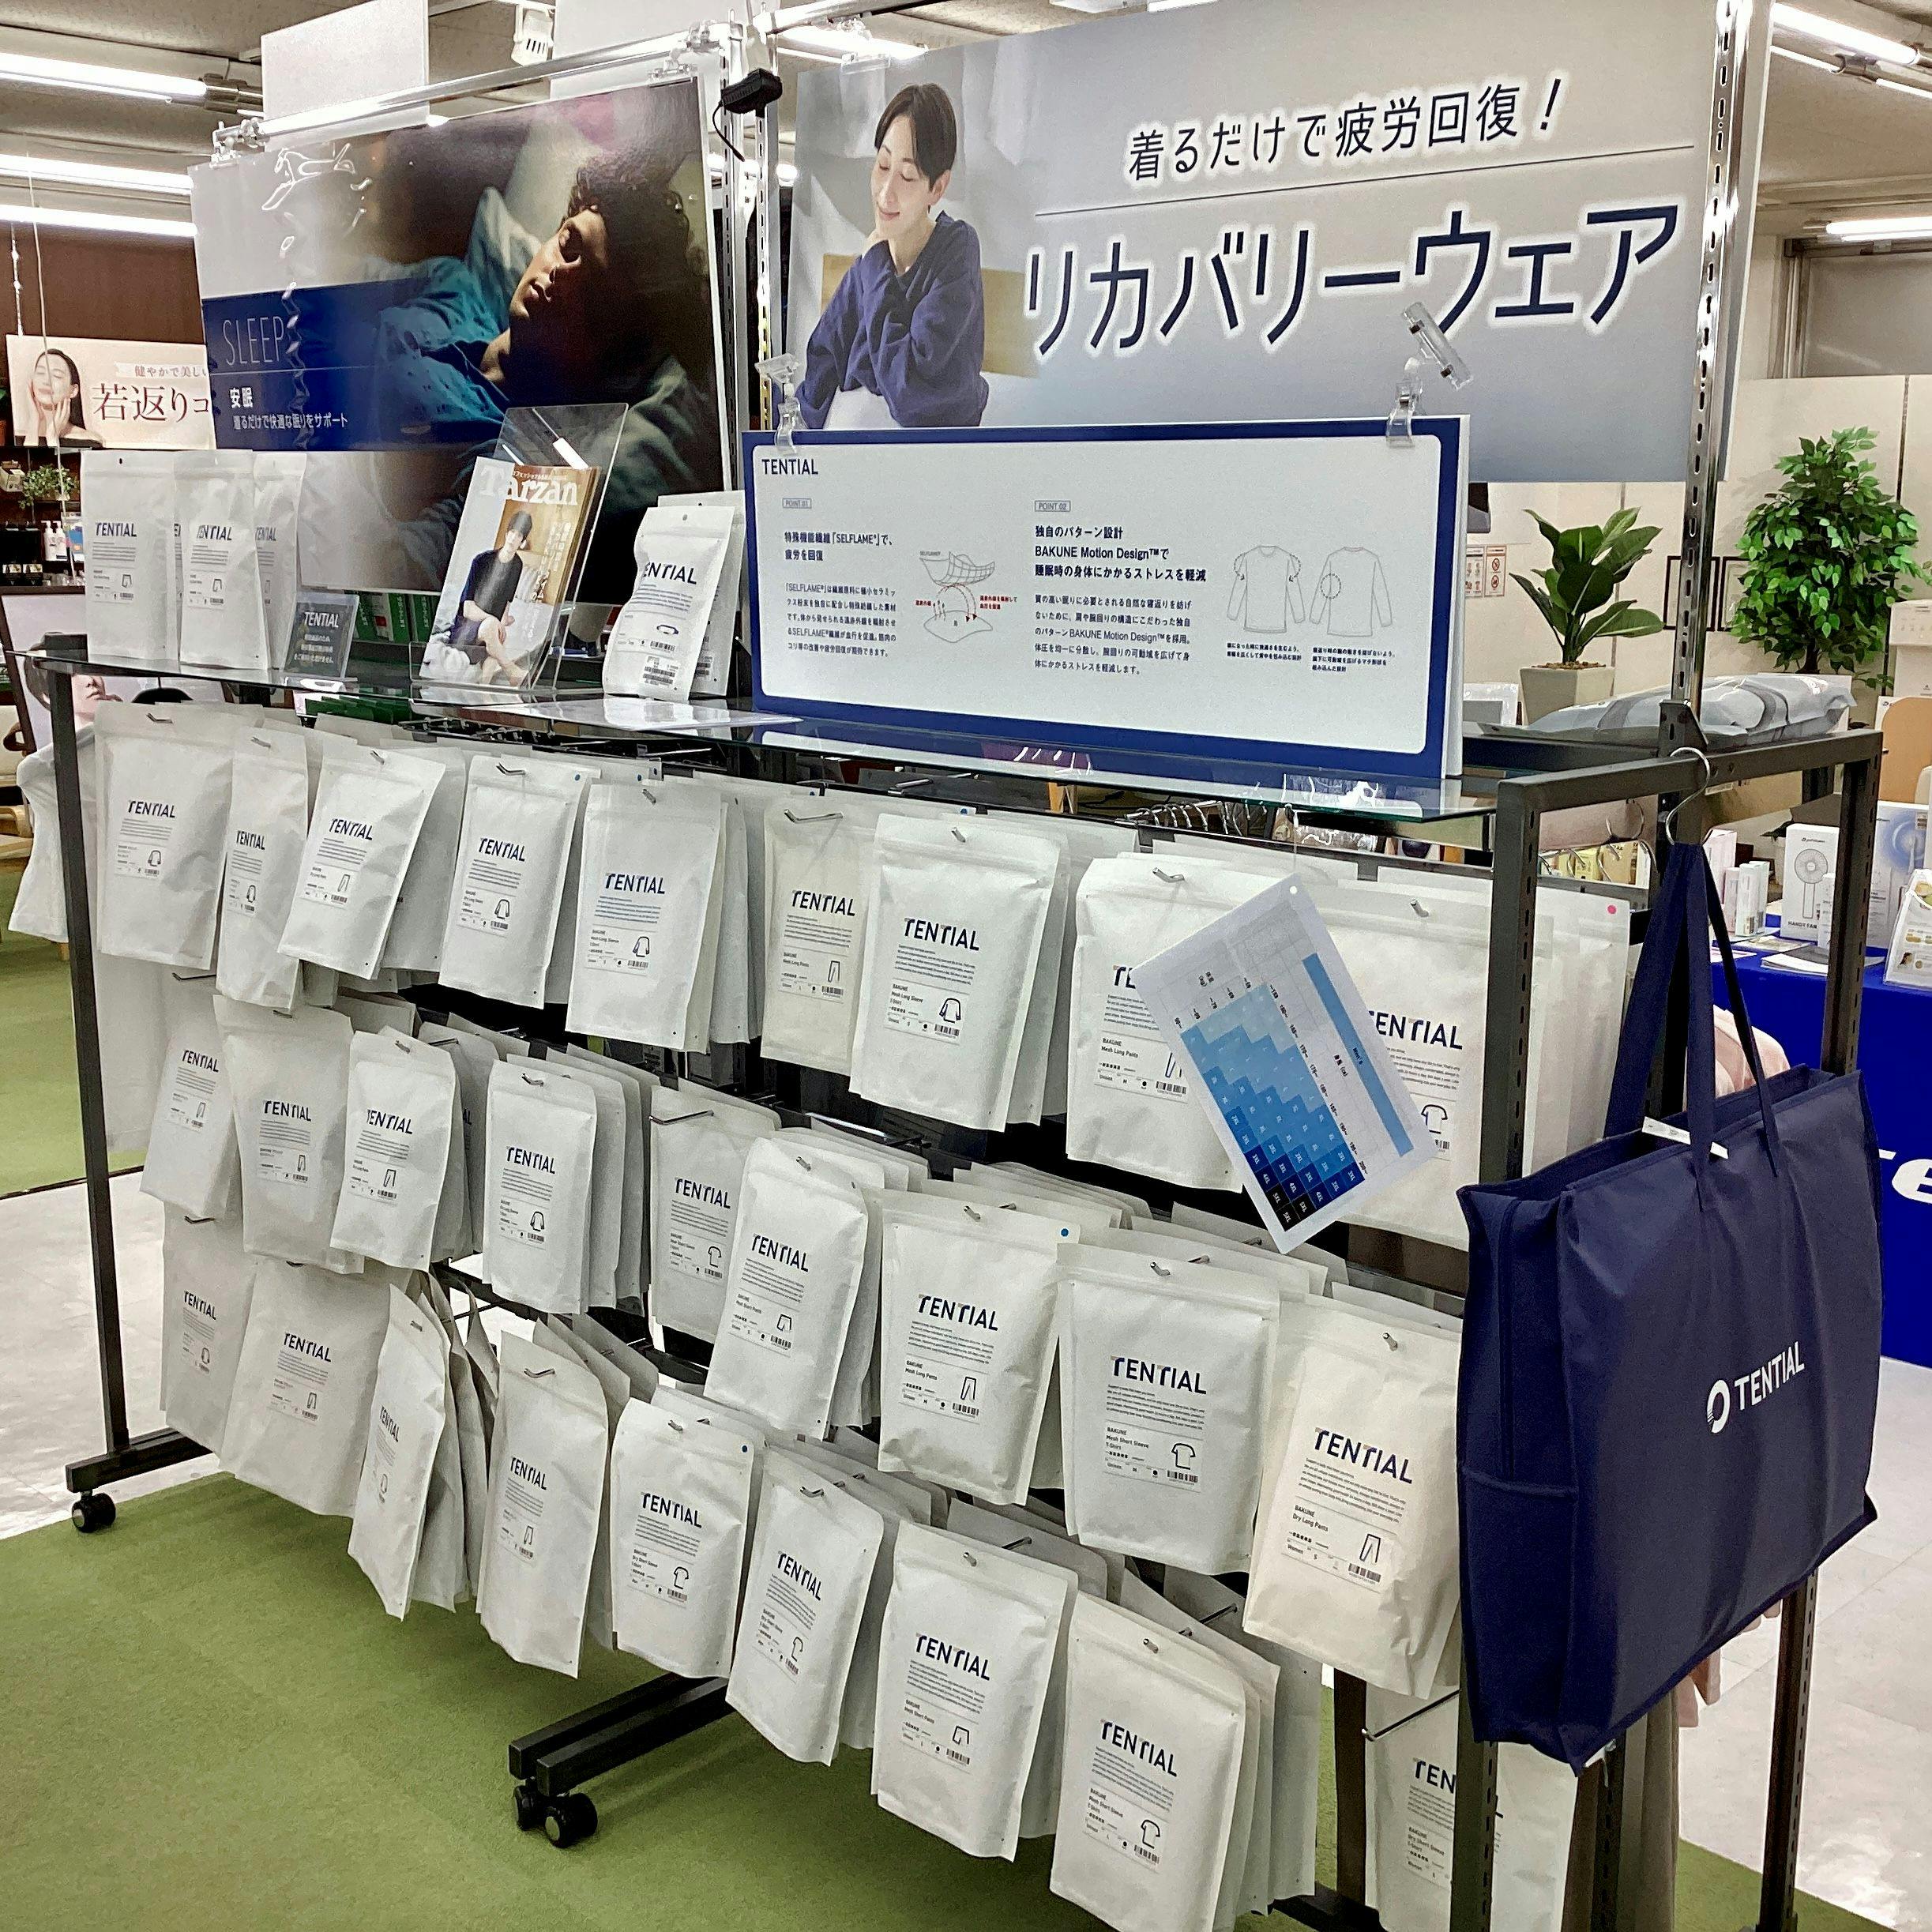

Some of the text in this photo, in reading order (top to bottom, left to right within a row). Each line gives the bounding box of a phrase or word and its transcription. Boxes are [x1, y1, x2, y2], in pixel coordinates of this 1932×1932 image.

[1128, 78, 1562, 182] 着るだけで疲労回復！
[1028, 203, 1677, 355] リカバリーウェア
[222, 317, 284, 366] SLEEP
[229, 386, 254, 408] 安眠
[761, 457, 818, 476] TENTIAL
[1038, 502, 1067, 511] POINT 02
[94, 522, 137, 538] TENTIAL
[1036, 524, 1123, 540] 独自のパターン設計
[785, 549, 824, 562] 疲労を回復
[1035, 545, 1077, 558] BAKUNE
[1081, 547, 1113, 559] Motion
[1035, 564, 1207, 582] 睡眠時の身体にかかるストレスを軽減
[304, 611, 339, 628] TENTIAL
[1035, 659, 1141, 675] 体にかかるストレスを軽減します。
[128, 799, 176, 818] TENTIAL
[235, 829, 265, 851] TENTIAL
[329, 817, 374, 841] TENTIAL
[477, 836, 526, 863] TENTIAL
[604, 872, 666, 895] TENTIAL
[791, 889, 856, 917] TENTIAL
[904, 916, 980, 952] TENTIAL
[182, 1049, 220, 1073] TENTIAL
[262, 1098, 312, 1122] TENTIAL
[366, 1108, 414, 1135] TENTIAL
[506, 1145, 556, 1175] TENTIAL
[675, 1177, 731, 1210] TENTIAL
[752, 1233, 810, 1272] TENTIAL
[183, 1290, 216, 1321] TENTIAL
[919, 1293, 998, 1332] TENTIAL
[284, 1331, 332, 1363] TENTIAL
[1110, 1355, 1207, 1395] TENTIAL
[1735, 1341, 1806, 1411] TENTIAL
[380, 1404, 400, 1443] TENTIAL
[1106, 1441, 1122, 1450] T-Shirt
[1314, 1426, 1413, 1484] TENTIAL
[509, 1457, 547, 1490] TENTIAL
[641, 1491, 702, 1528] TENTIAL
[1292, 1513, 1329, 1532] Dry Long Pants
[1295, 1505, 1315, 1517] BAKUNE
[1287, 1543, 1304, 1554] Women
[777, 1550, 823, 1602] TENTIAL
[915, 1633, 991, 1681] TENTIAL
[1099, 1719, 1178, 1778] TENTIAL
